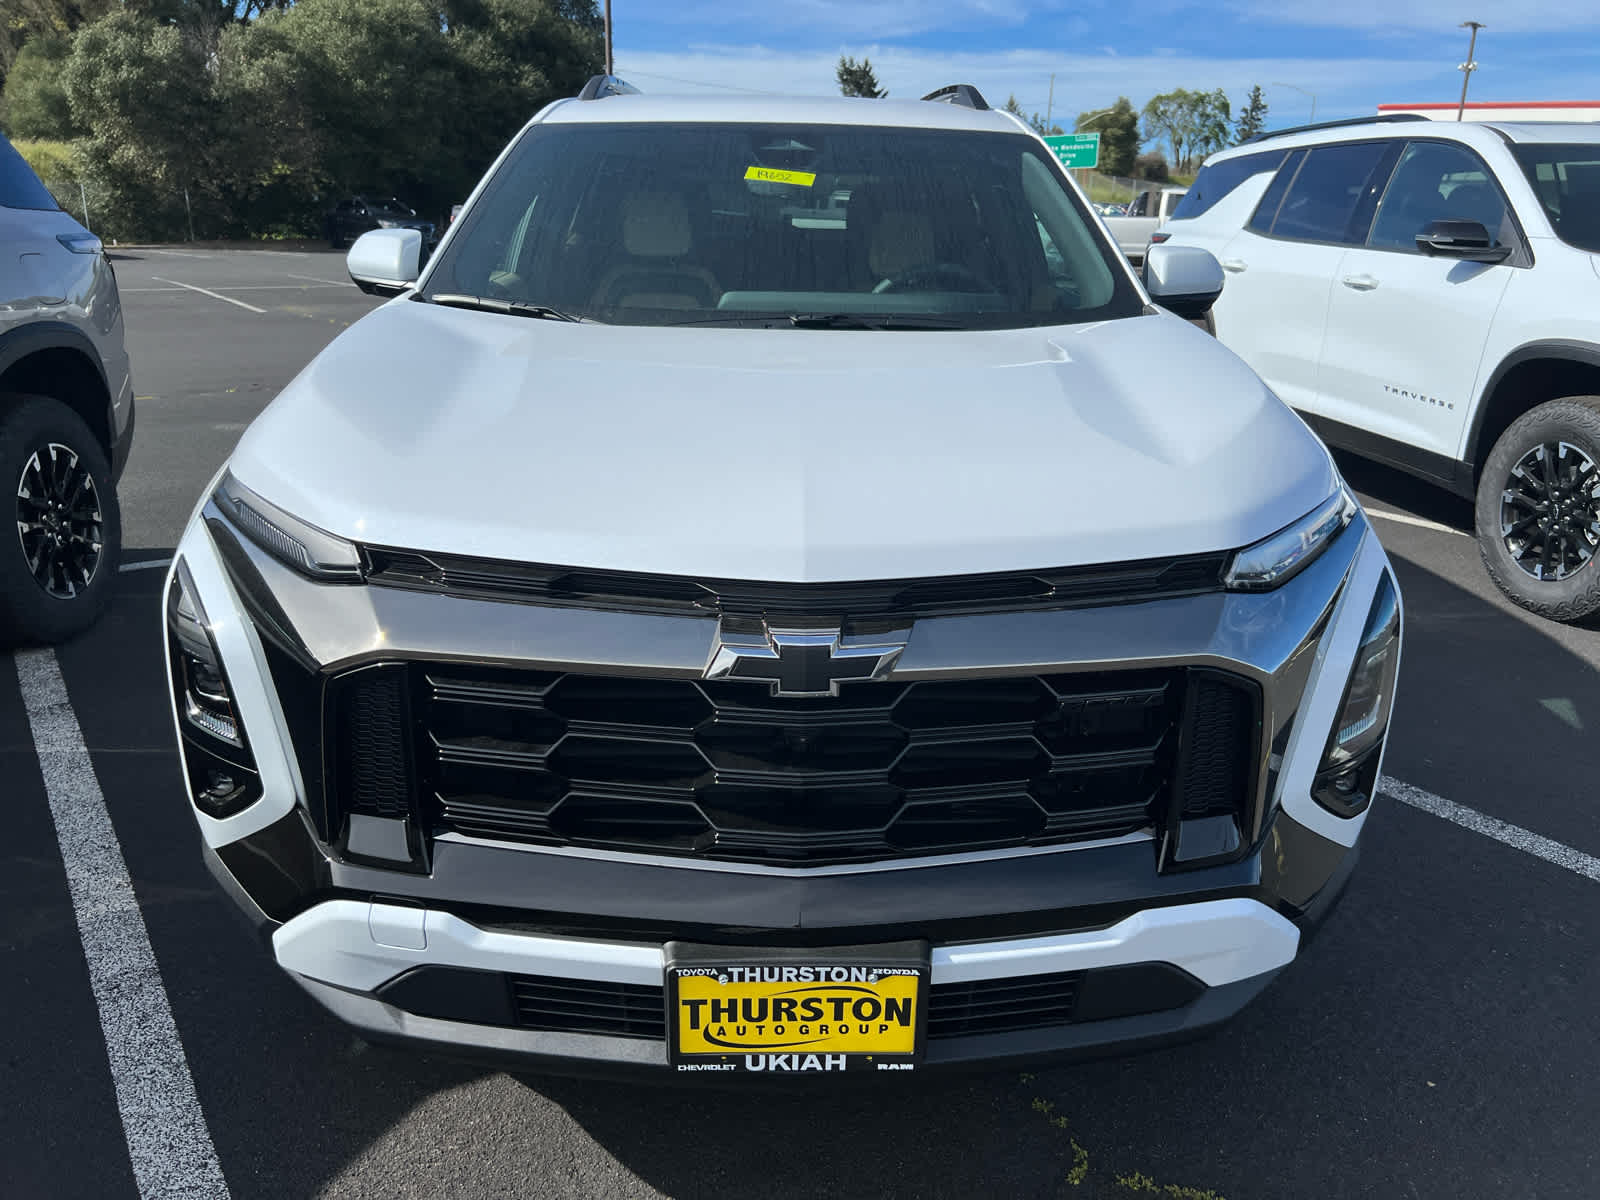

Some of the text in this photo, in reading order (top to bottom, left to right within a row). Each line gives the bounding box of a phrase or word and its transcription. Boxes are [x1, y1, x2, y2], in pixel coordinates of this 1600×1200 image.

[1384, 384, 1454, 410] TRAVERSE
[676, 969, 719, 977] TOYOTA
[727, 967, 867, 983] THURSTON
[872, 968, 921, 976] HONDA
[681, 997, 912, 1030] THURSTON
[744, 1054, 847, 1071] UKIAH
